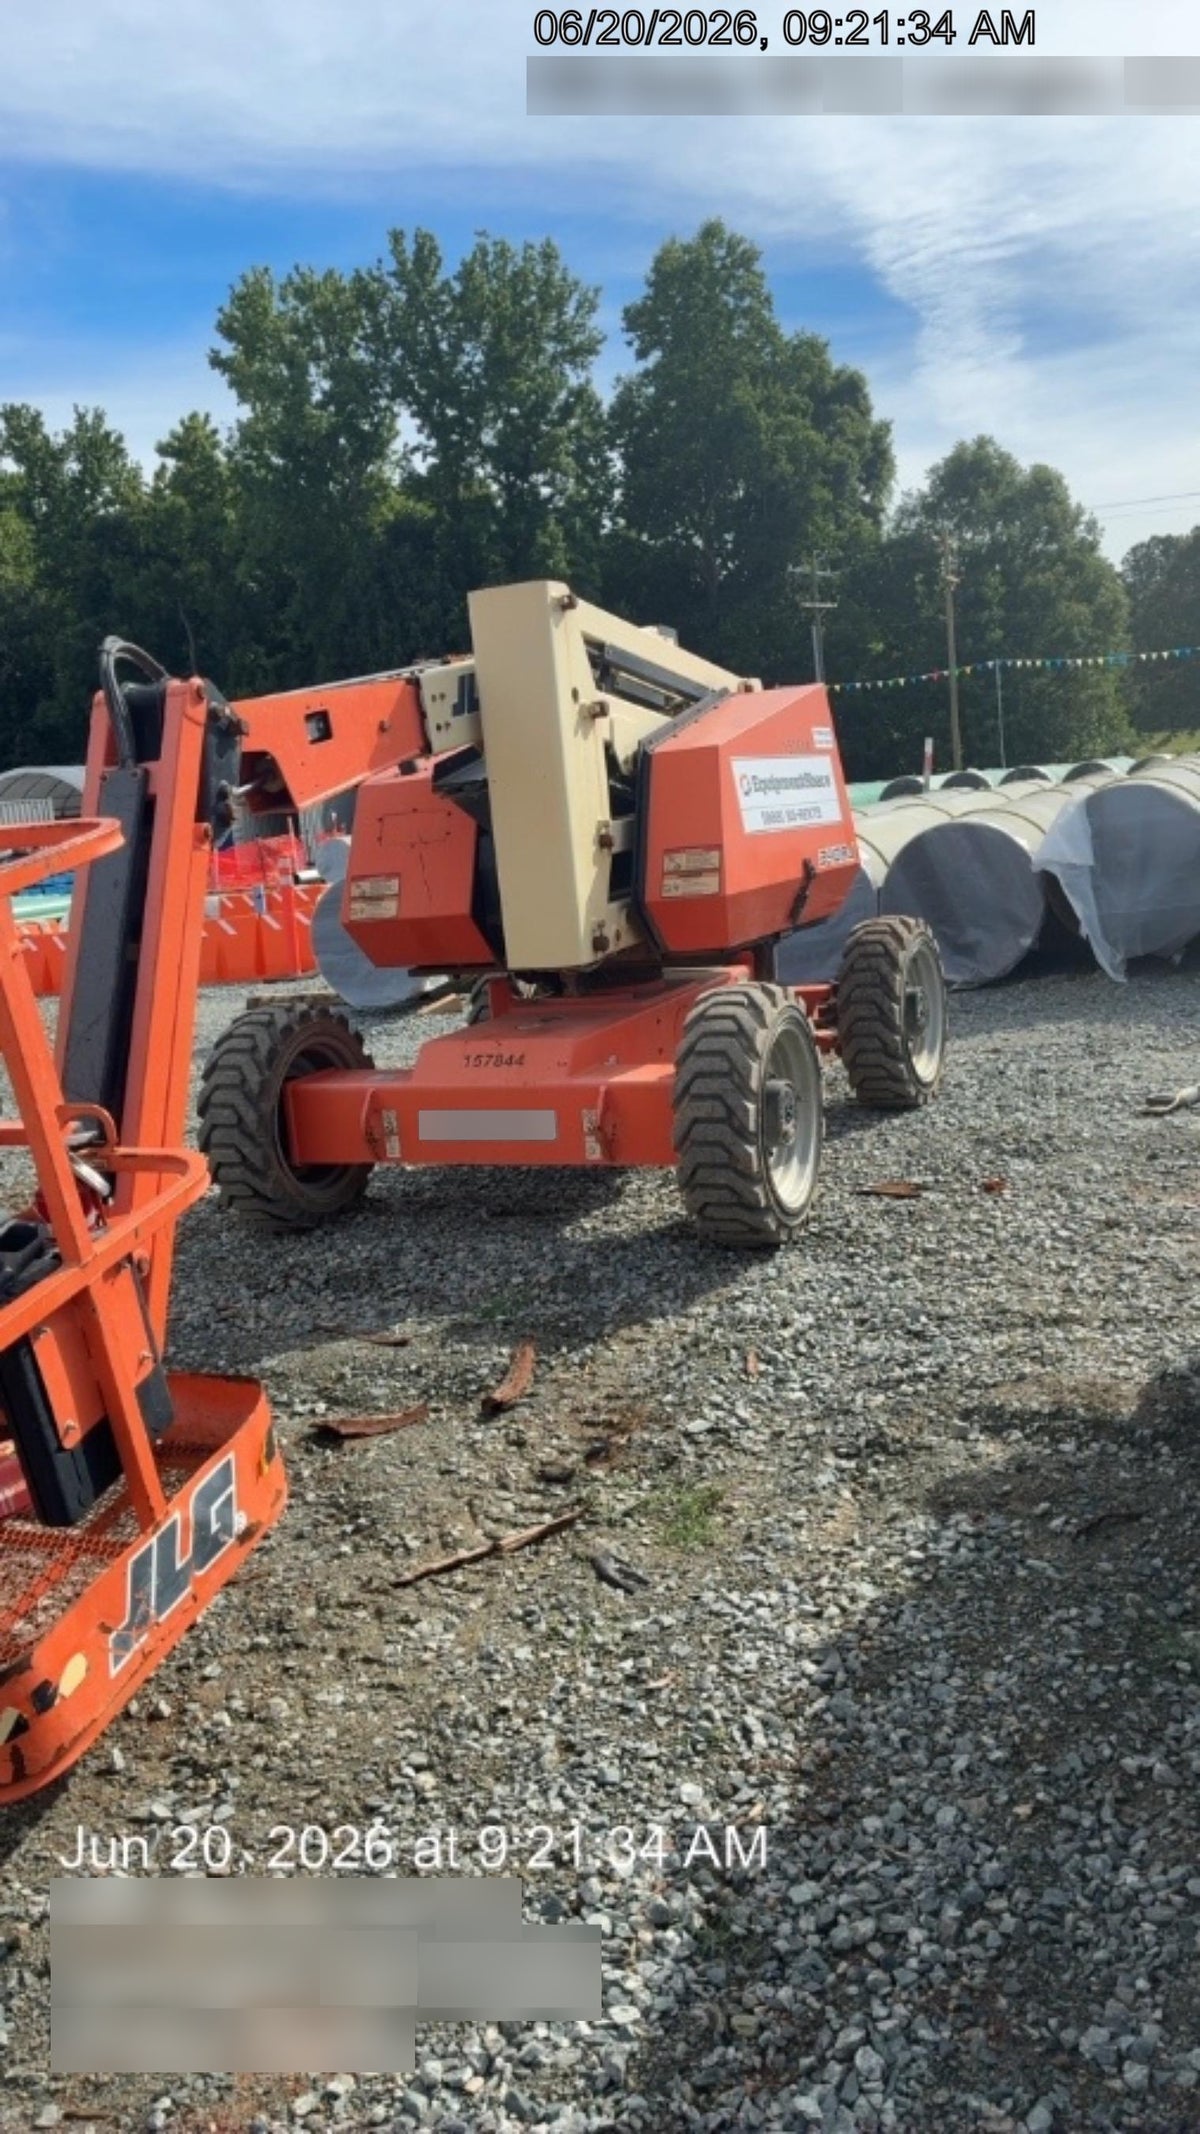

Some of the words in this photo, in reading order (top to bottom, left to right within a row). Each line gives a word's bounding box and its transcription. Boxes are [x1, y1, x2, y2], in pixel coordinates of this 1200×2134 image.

[453, 672, 480, 717] JL
[464, 1052, 526, 1068] 157844
[108, 1450, 236, 1678] JLG
